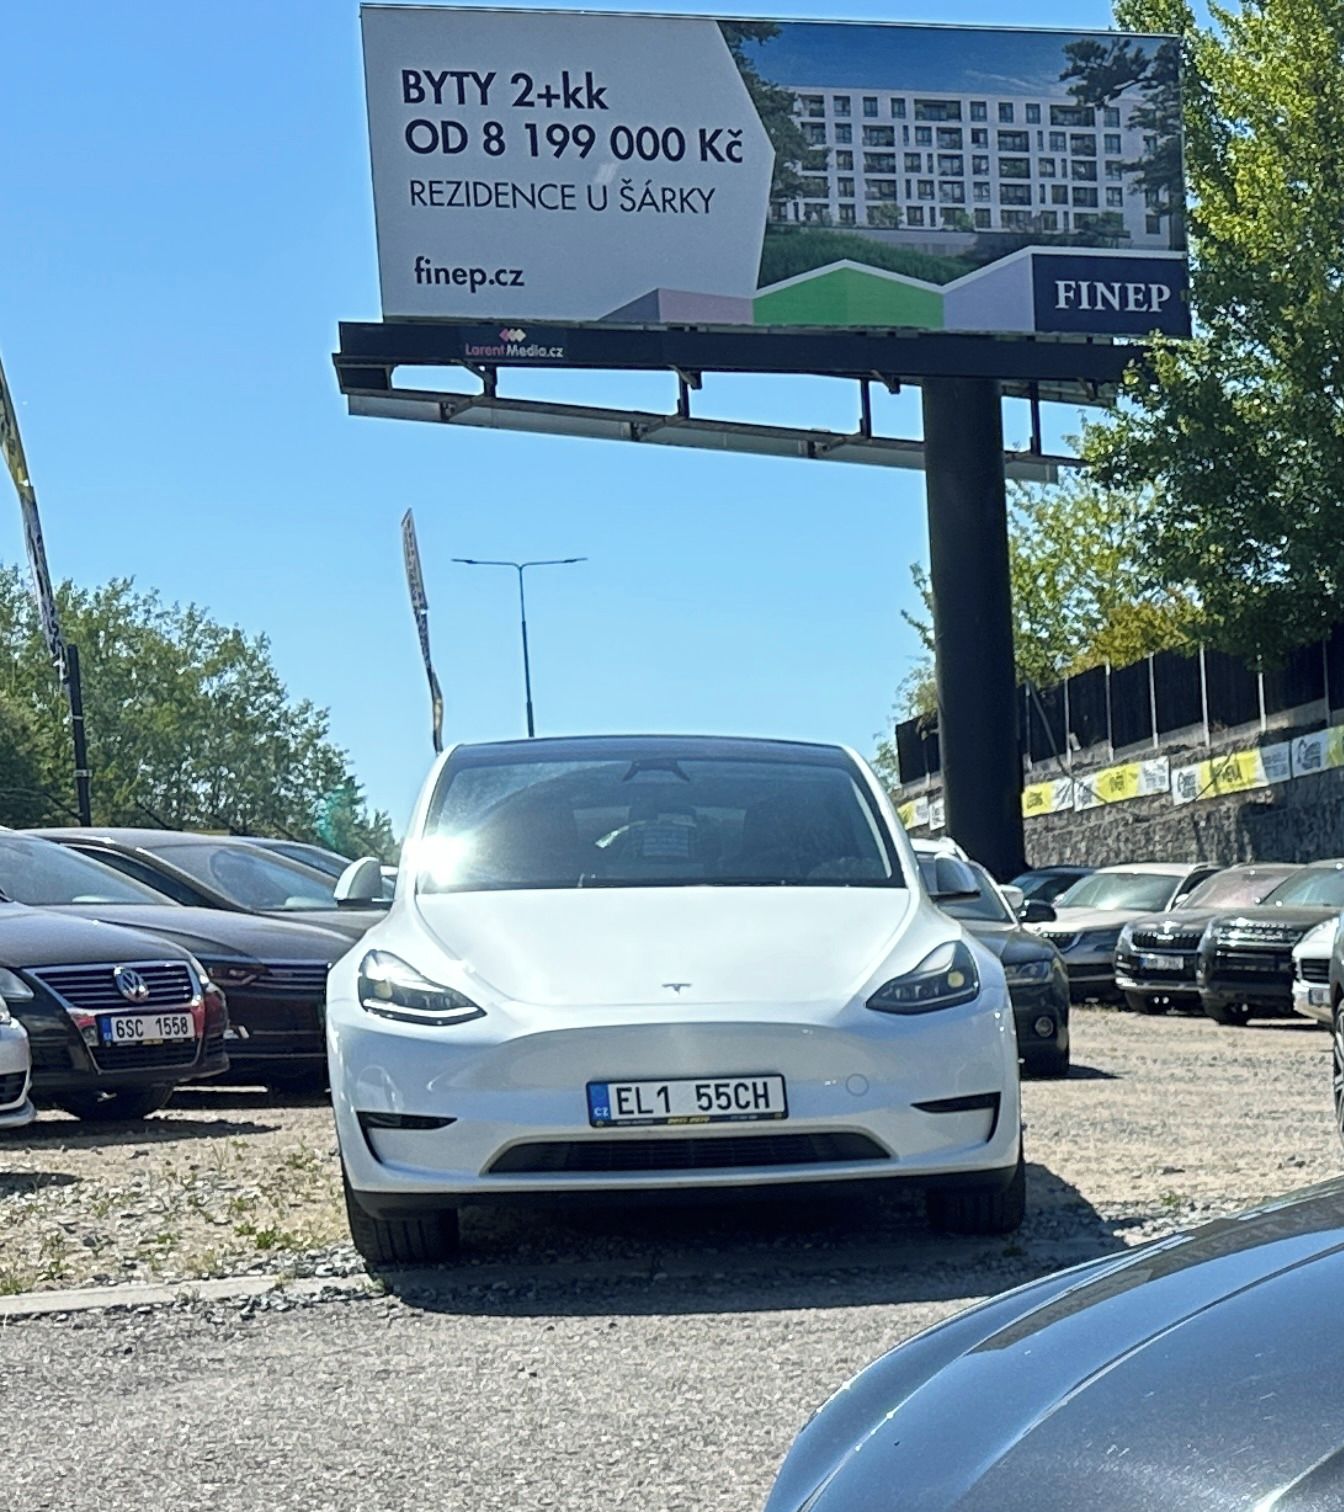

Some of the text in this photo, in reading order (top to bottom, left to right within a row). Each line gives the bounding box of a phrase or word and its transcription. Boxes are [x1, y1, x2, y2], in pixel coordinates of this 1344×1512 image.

[401, 69, 609, 110] BYTY 2+kk
[405, 119, 744, 164] OD 8 199 000 Kč
[409, 177, 717, 214] REZIDENCE U ŠÁRKY
[414, 255, 525, 294] finep.cz
[1054, 280, 1172, 313] FINEP
[464, 342, 564, 359] LarentMedia.cz
[115, 1016, 189, 1039] 6SC 1558
[594, 1106, 609, 1118] CZ
[616, 1081, 771, 1116] EL1 55CH
